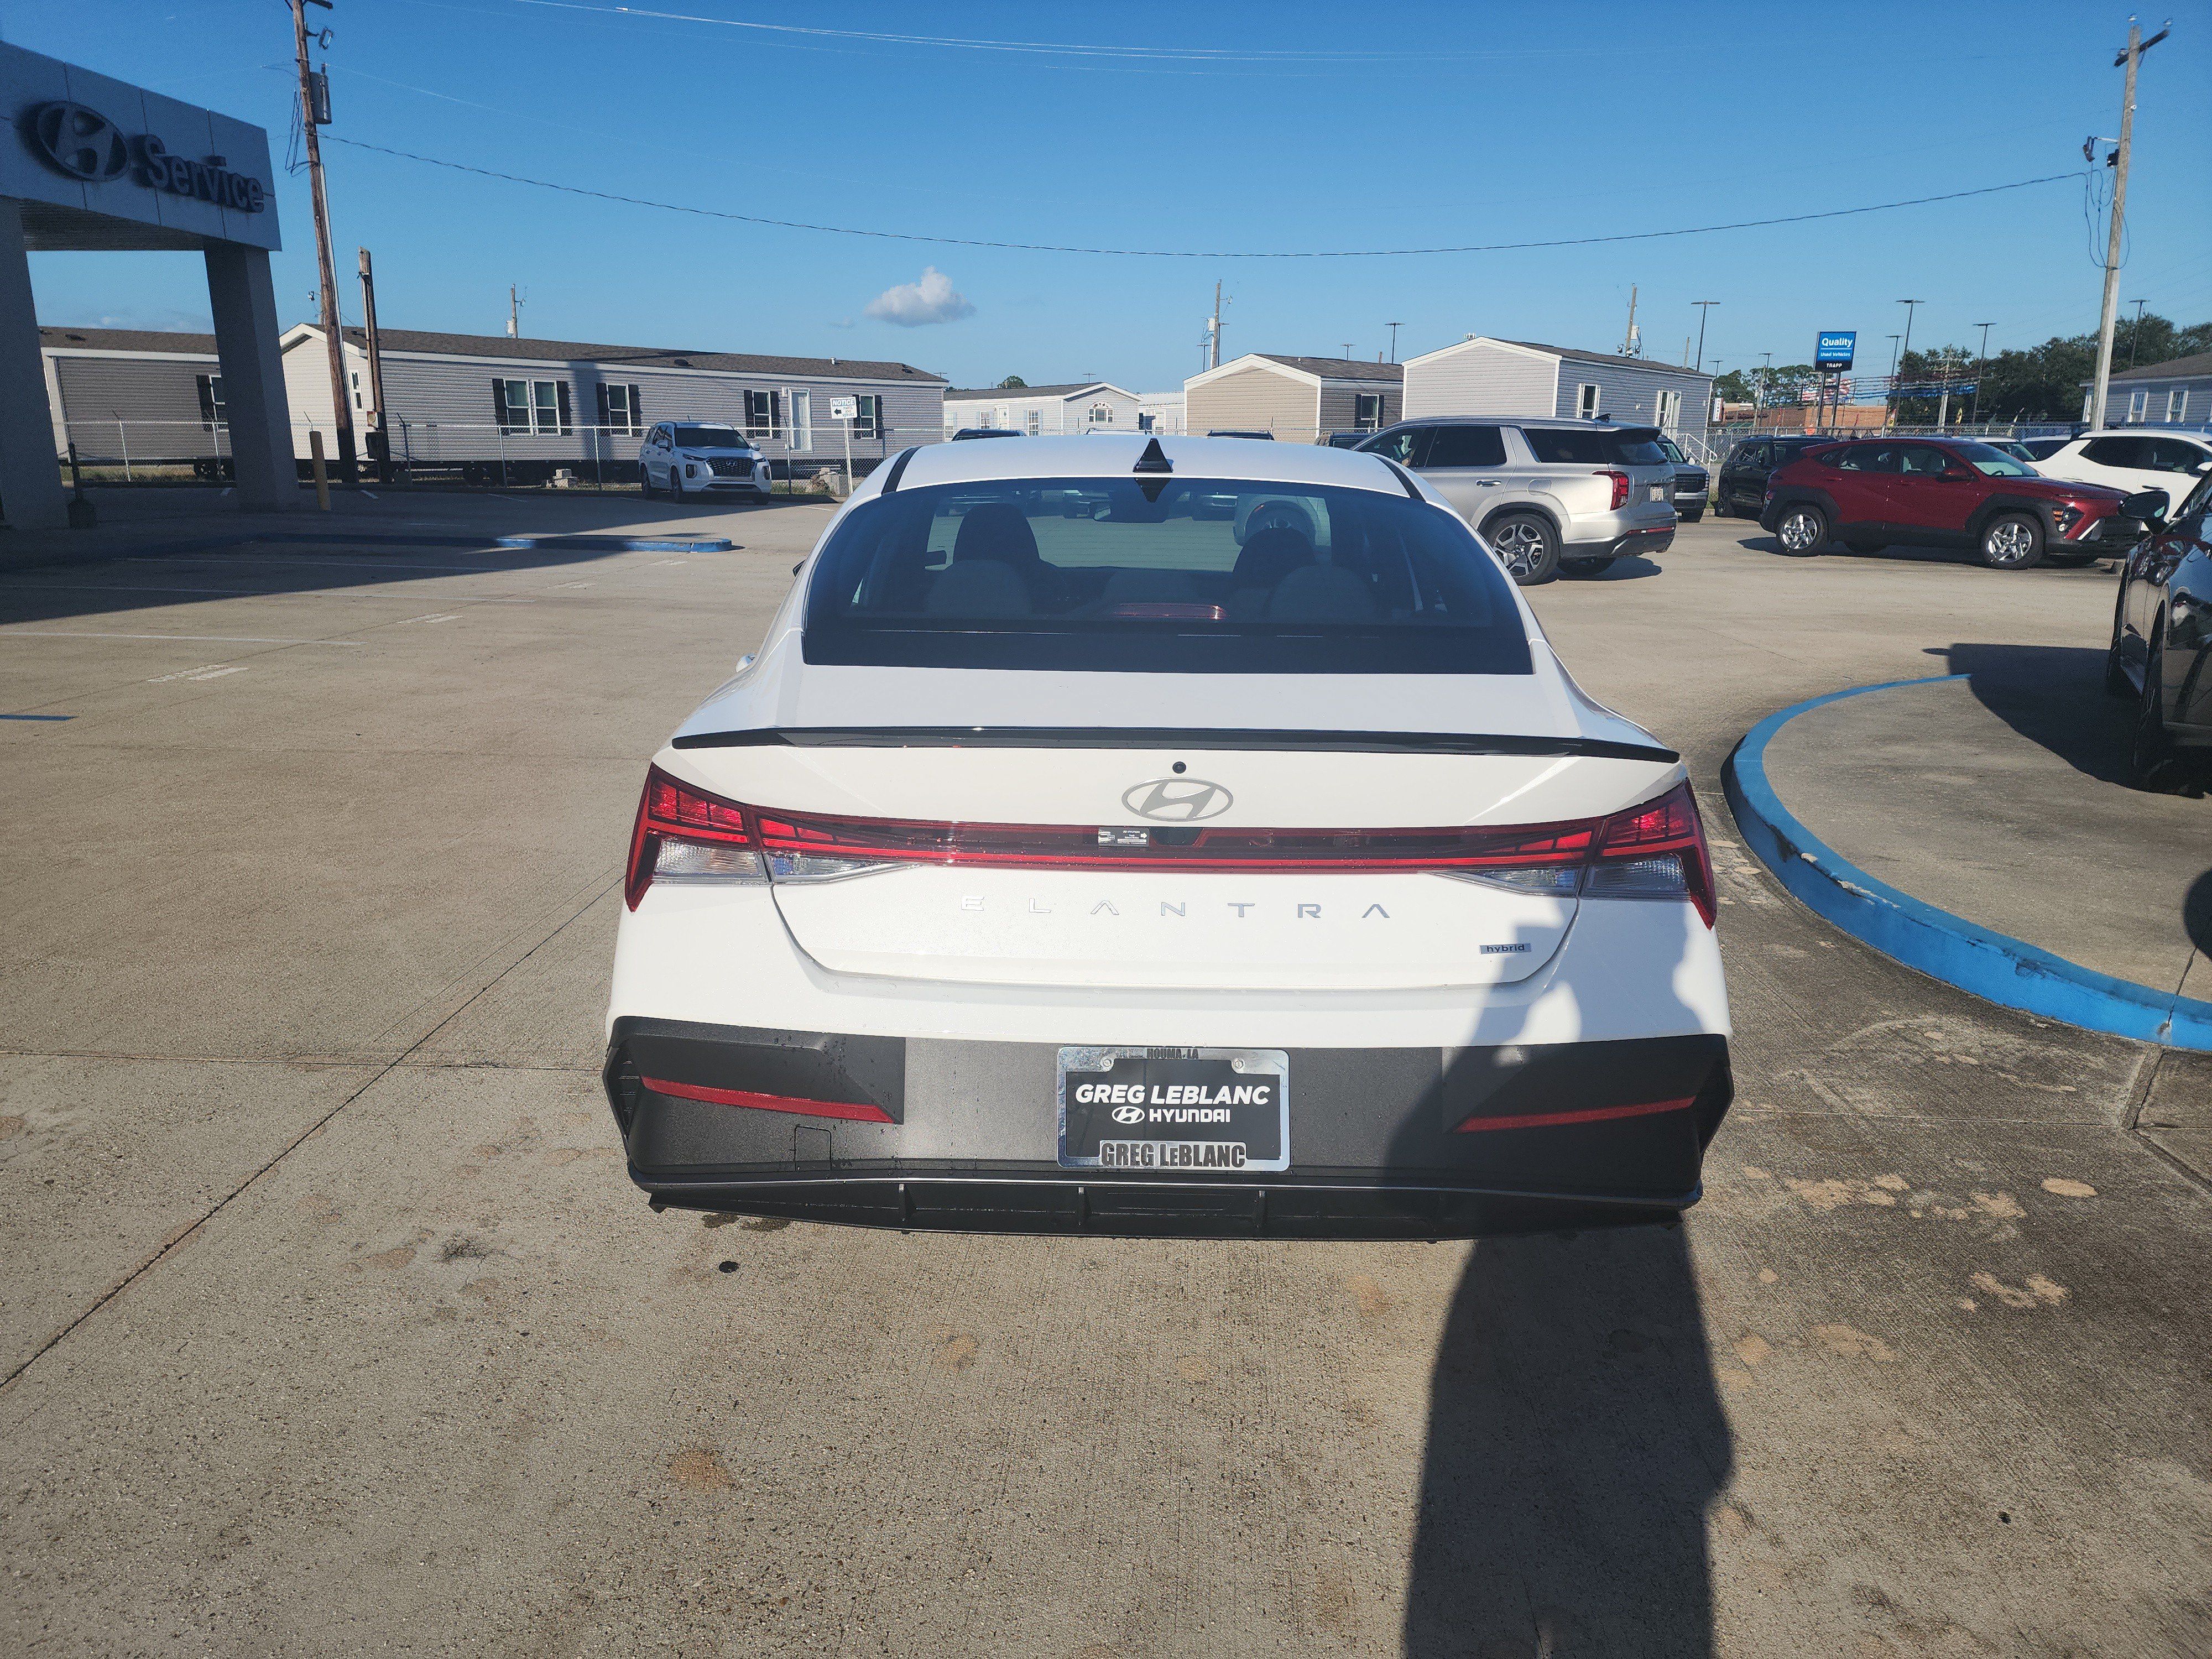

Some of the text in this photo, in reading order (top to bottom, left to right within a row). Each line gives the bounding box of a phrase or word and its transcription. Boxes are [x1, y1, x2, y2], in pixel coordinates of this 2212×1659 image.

[142, 134, 265, 214] Service
[1822, 337, 1853, 348] Quality
[961, 895, 1390, 919] ELANTRA
[1486, 944, 1525, 953] hybrid
[1187, 1048, 1199, 1060] LA
[1076, 1084, 1271, 1105] GREG LEBLANC
[1149, 1108, 1231, 1123] HYUNDAI
[1101, 1142, 1154, 1167] GREG
